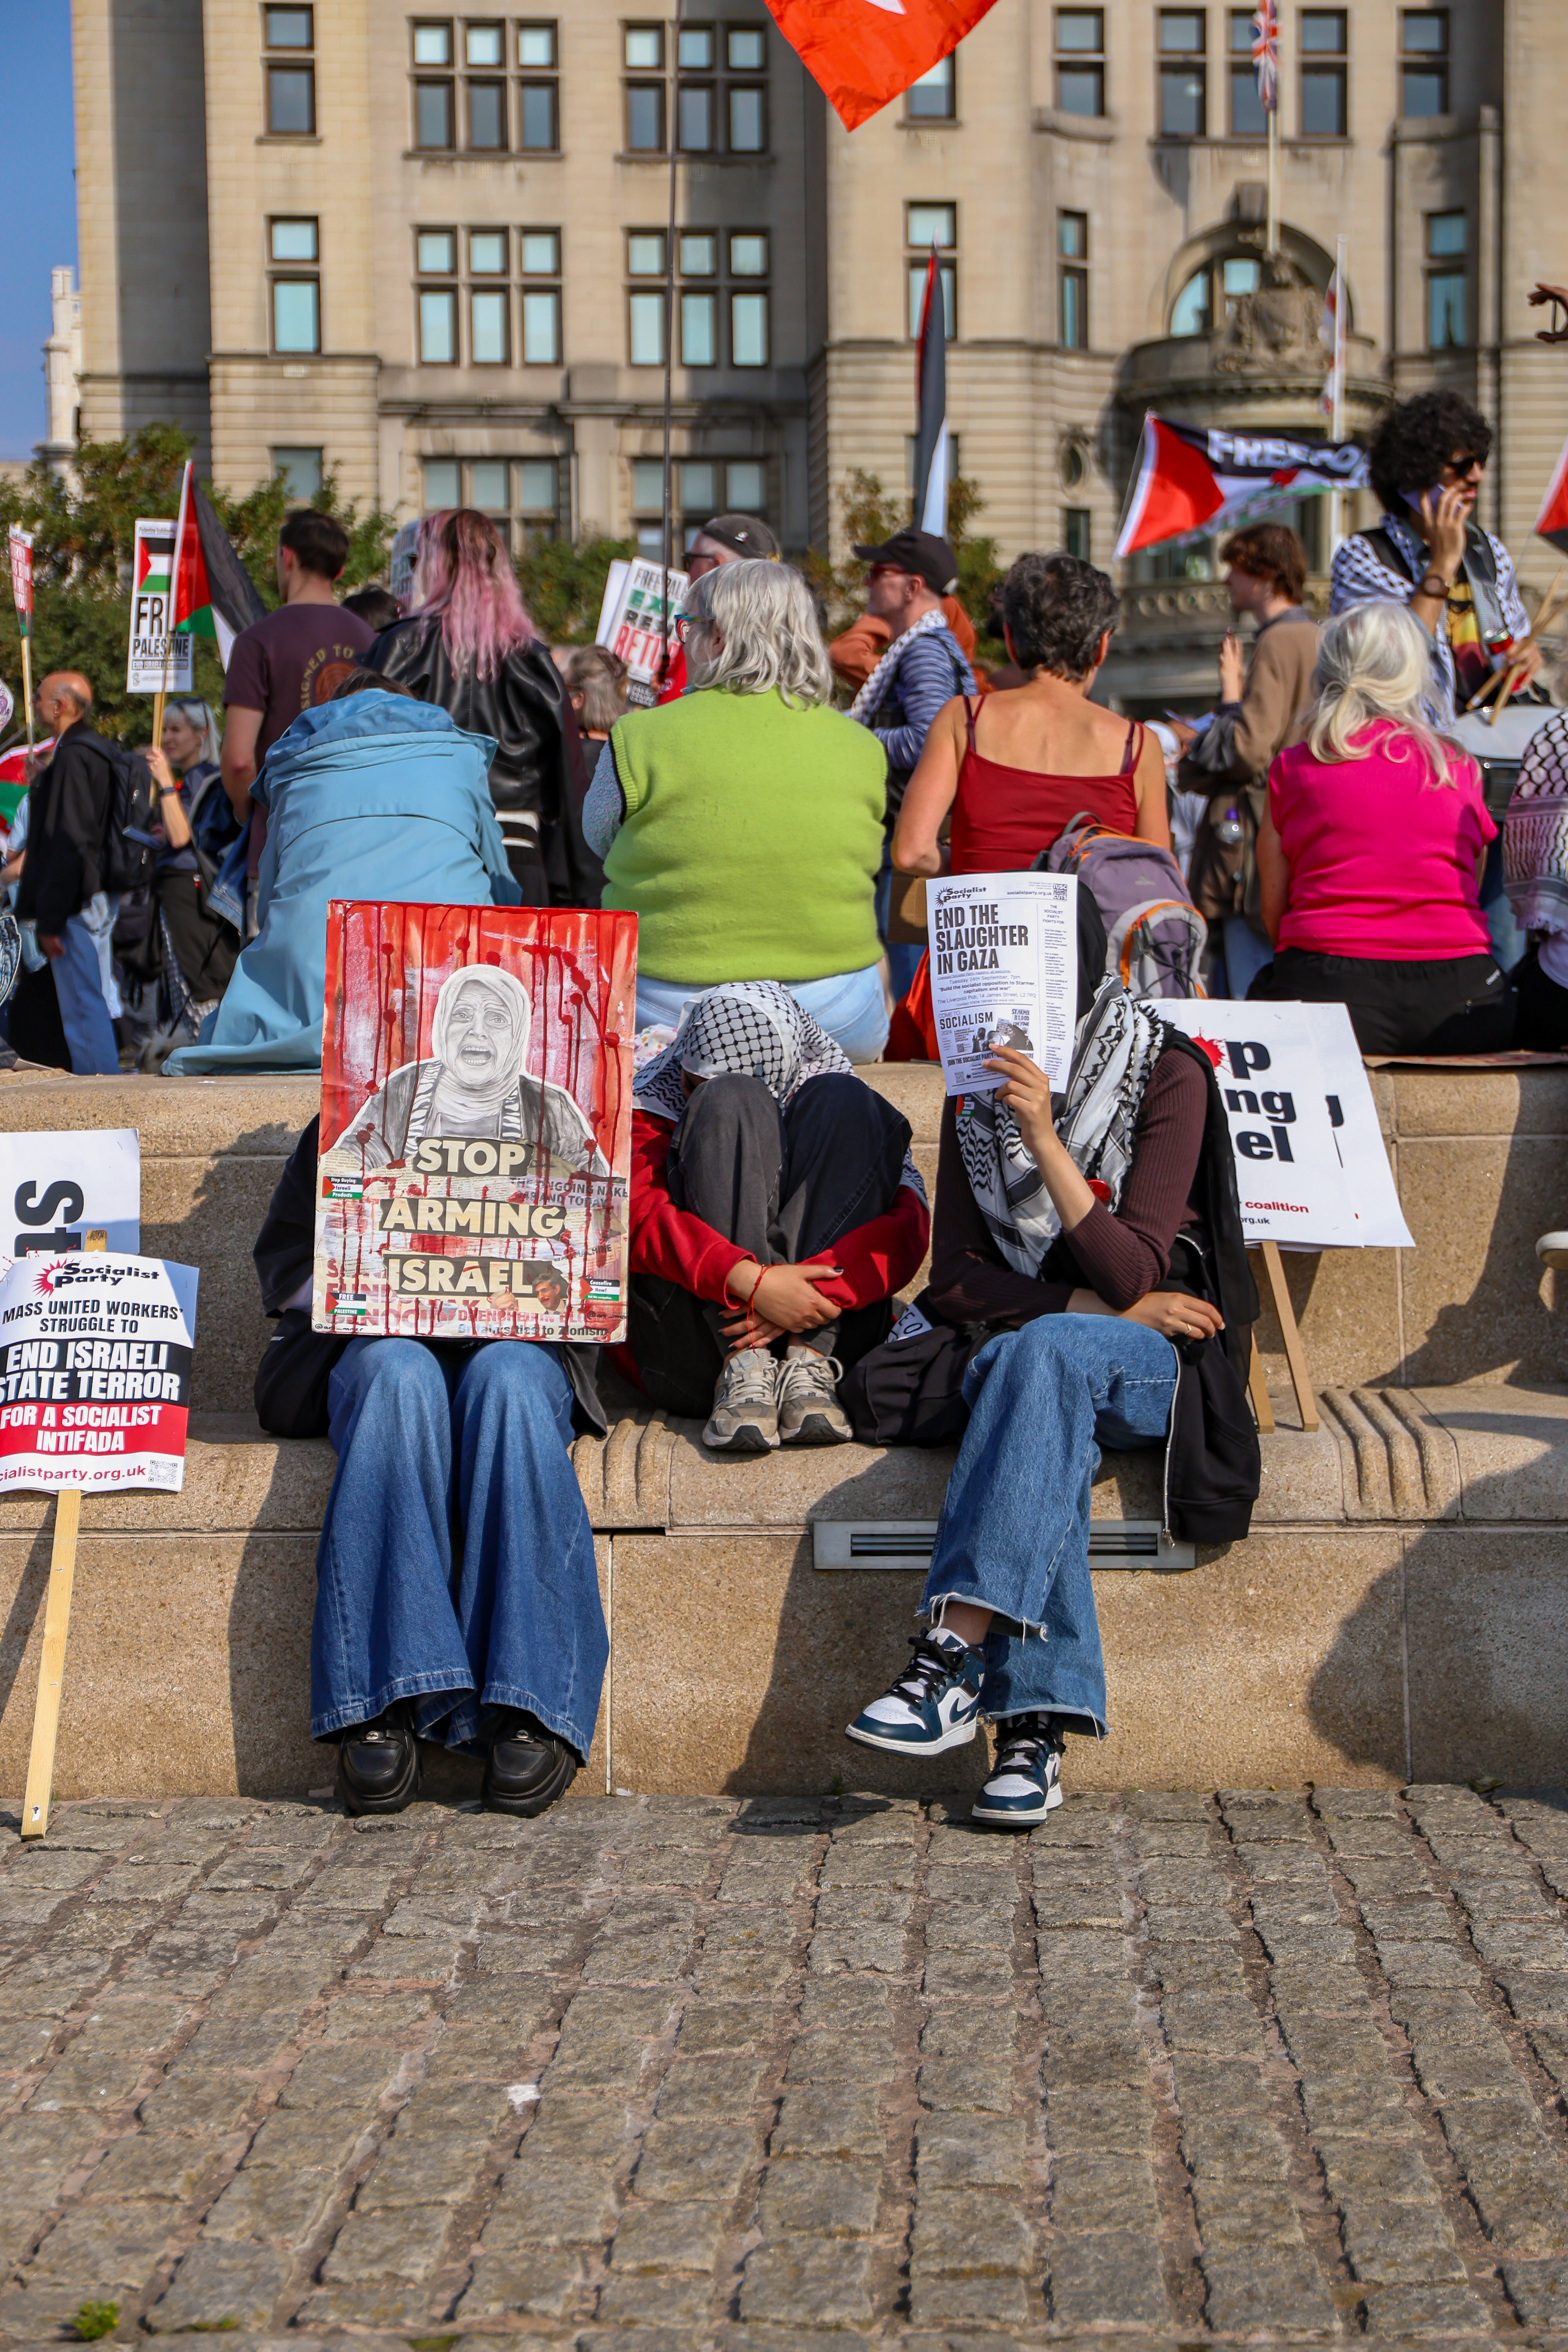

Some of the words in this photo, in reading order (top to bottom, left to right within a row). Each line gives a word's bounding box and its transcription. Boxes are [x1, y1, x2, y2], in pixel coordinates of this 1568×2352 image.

[134, 638, 189, 658] PALESTINE
[332, 644, 354, 659] TO
[946, 887, 987, 895] Socialist
[935, 906, 965, 931] END
[969, 904, 999, 926] THE
[935, 925, 1028, 953] SLAUGHTER
[937, 952, 953, 975] IN
[957, 948, 999, 972] GAZA
[939, 1011, 993, 1030] SOCIALISM
[963, 1055, 981, 1064] SOCIALIST
[416, 1139, 525, 1176] STOP
[568, 1195, 608, 1208] TODAY
[1245, 1201, 1309, 1213] coalition
[383, 1198, 564, 1238] ARMING
[62, 1262, 160, 1280] Socialist
[388, 1258, 532, 1294] ISRAEL
[2, 1301, 43, 1325] MASS
[48, 1299, 100, 1315] UNITED
[40, 1317, 114, 1333] STRUGGLE
[121, 1319, 138, 1334] TO
[542, 1325, 554, 1335] to
[6, 1341, 59, 1373] END
[66, 1340, 169, 1370] ISRAELI
[77, 1371, 181, 1401] TERROR
[0, 1405, 38, 1429] FOR
[42, 1406, 56, 1428] A
[62, 1405, 162, 1428] SOCIALIST
[36, 1430, 125, 1453] INTIFADA
